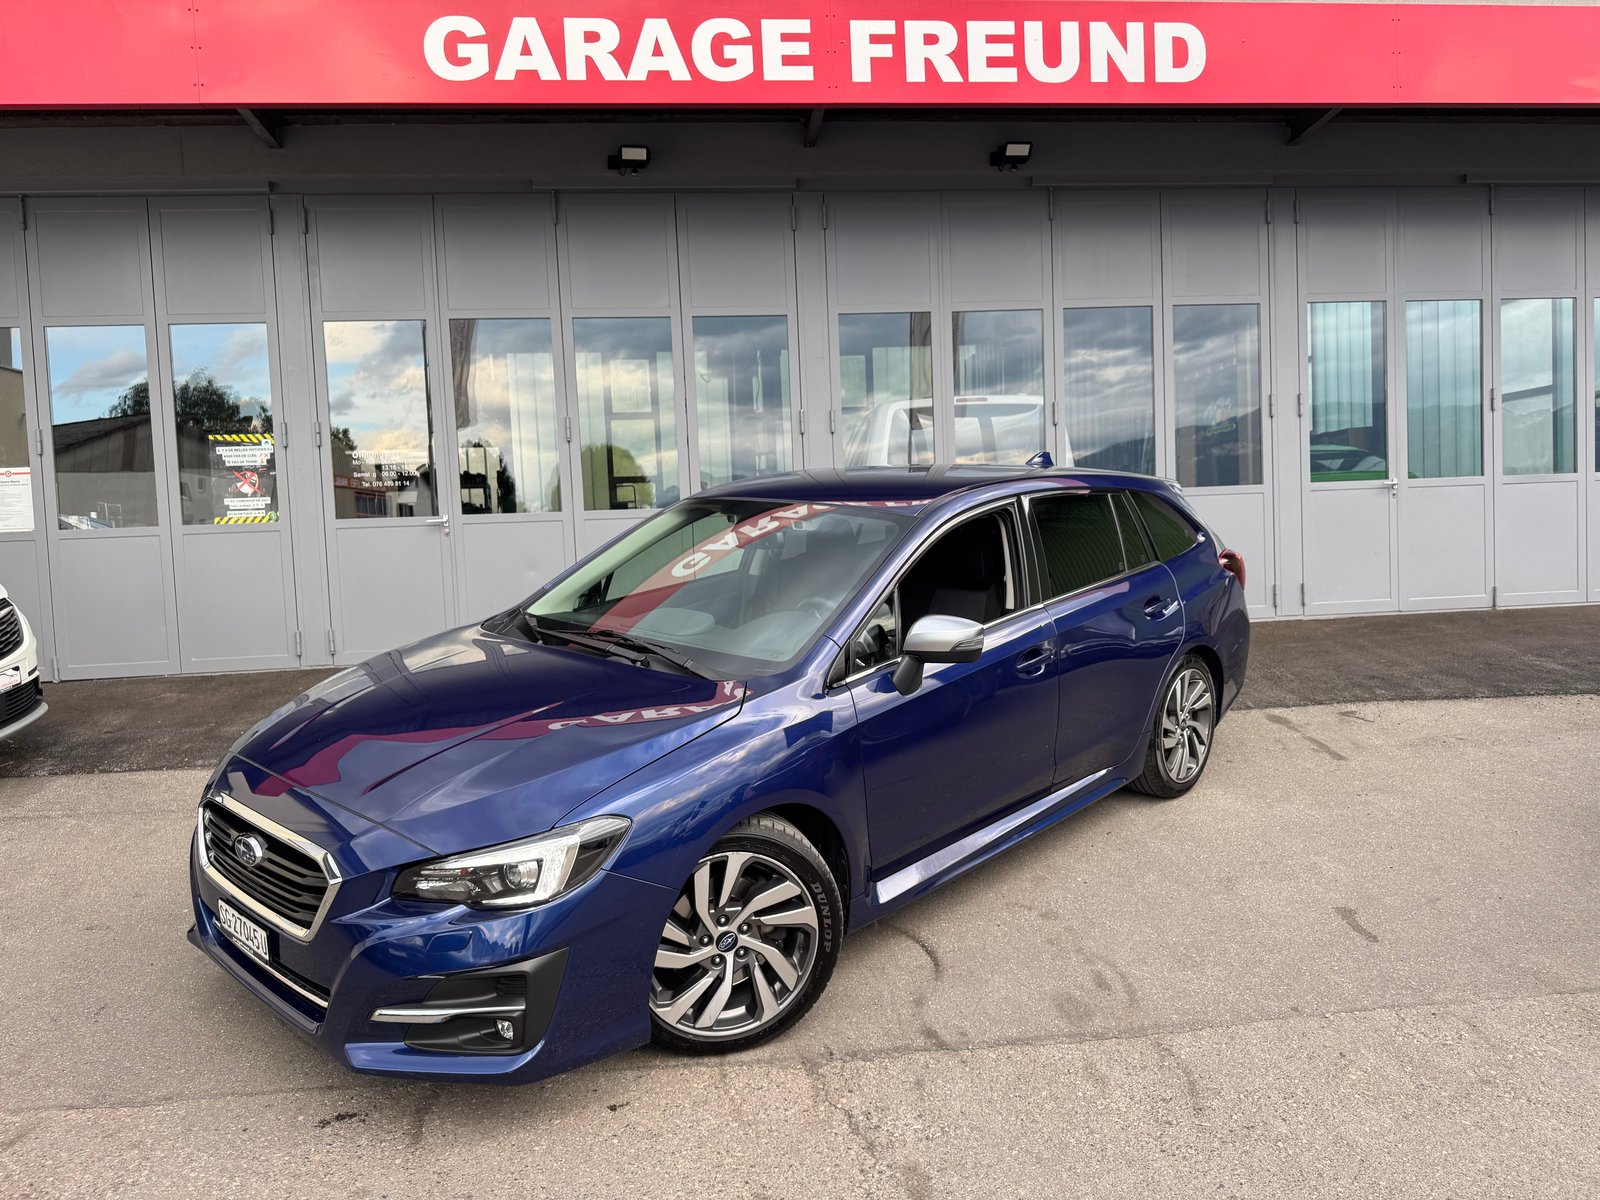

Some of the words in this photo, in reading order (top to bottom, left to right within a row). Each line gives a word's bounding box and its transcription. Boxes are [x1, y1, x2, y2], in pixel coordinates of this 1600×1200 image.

[423, 15, 814, 82] GARAGE
[849, 20, 1207, 83] FREUND
[811, 881, 833, 953] DUNLOP
